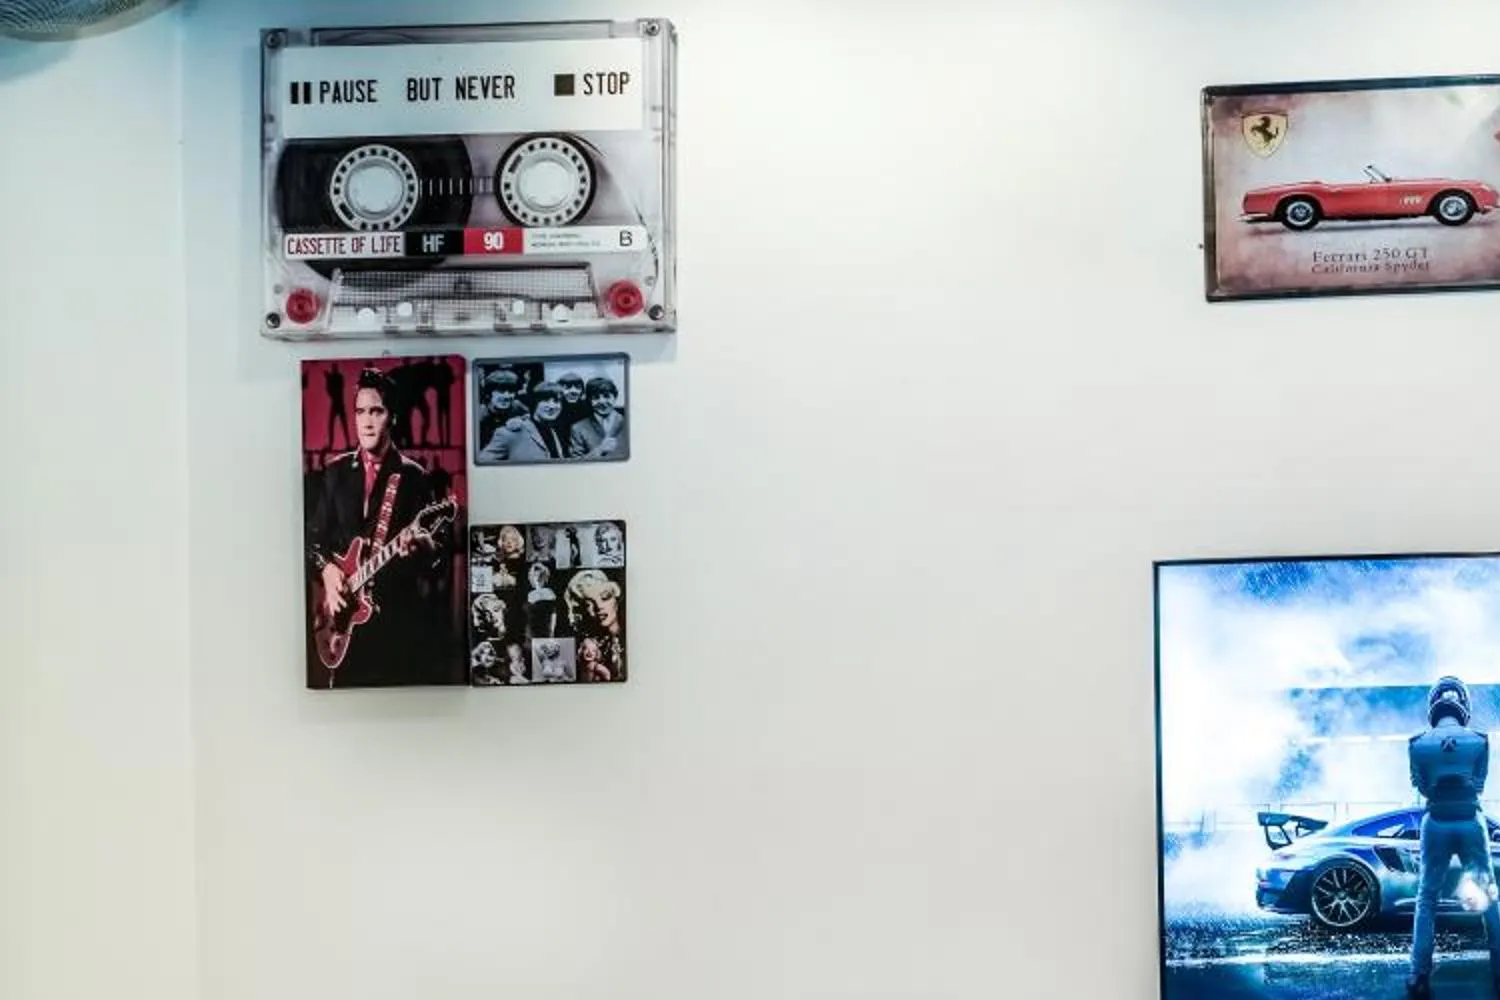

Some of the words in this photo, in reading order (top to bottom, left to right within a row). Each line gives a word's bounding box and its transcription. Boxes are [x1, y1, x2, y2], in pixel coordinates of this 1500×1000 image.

[319, 79, 378, 104] PAUSE
[406, 77, 443, 101] BUT
[455, 75, 516, 100] NEVER
[583, 71, 630, 96] STOP
[287, 237, 347, 255] CASSETTE
[351, 236, 367, 253] OF
[371, 235, 401, 253] LIFE
[422, 234, 445, 253] HF
[483, 231, 505, 251] 90
[619, 231, 633, 247] B
[1372, 247, 1401, 261] 250
